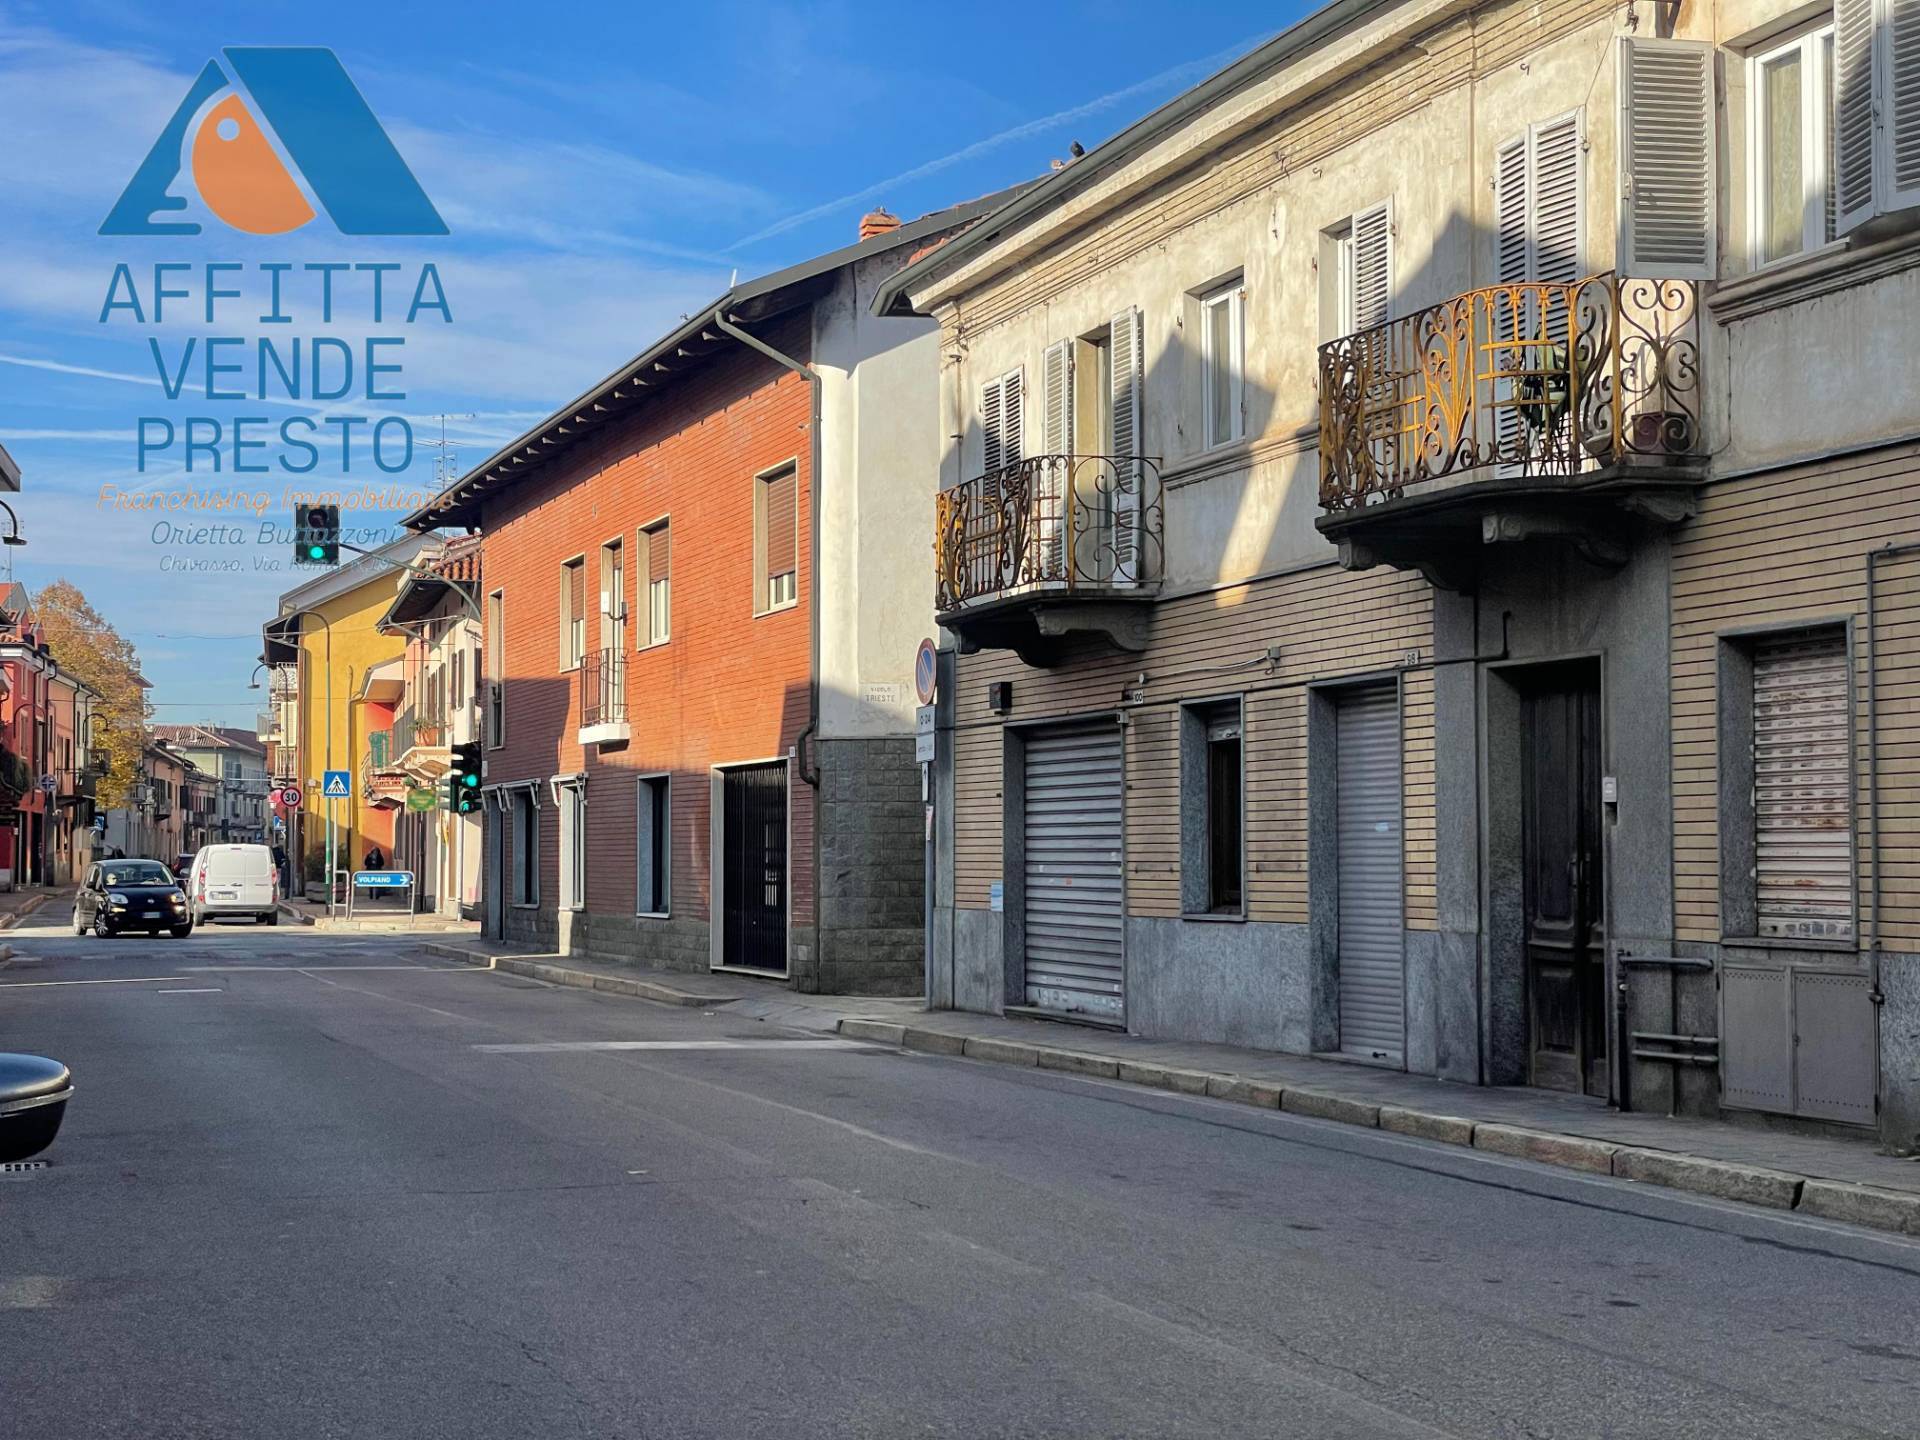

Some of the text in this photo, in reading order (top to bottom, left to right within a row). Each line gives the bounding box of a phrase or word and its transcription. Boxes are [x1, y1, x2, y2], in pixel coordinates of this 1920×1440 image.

[865, 694, 895, 703] TRIESTE
[285, 792, 298, 802] 30
[358, 876, 391, 884] VOLPIANO
